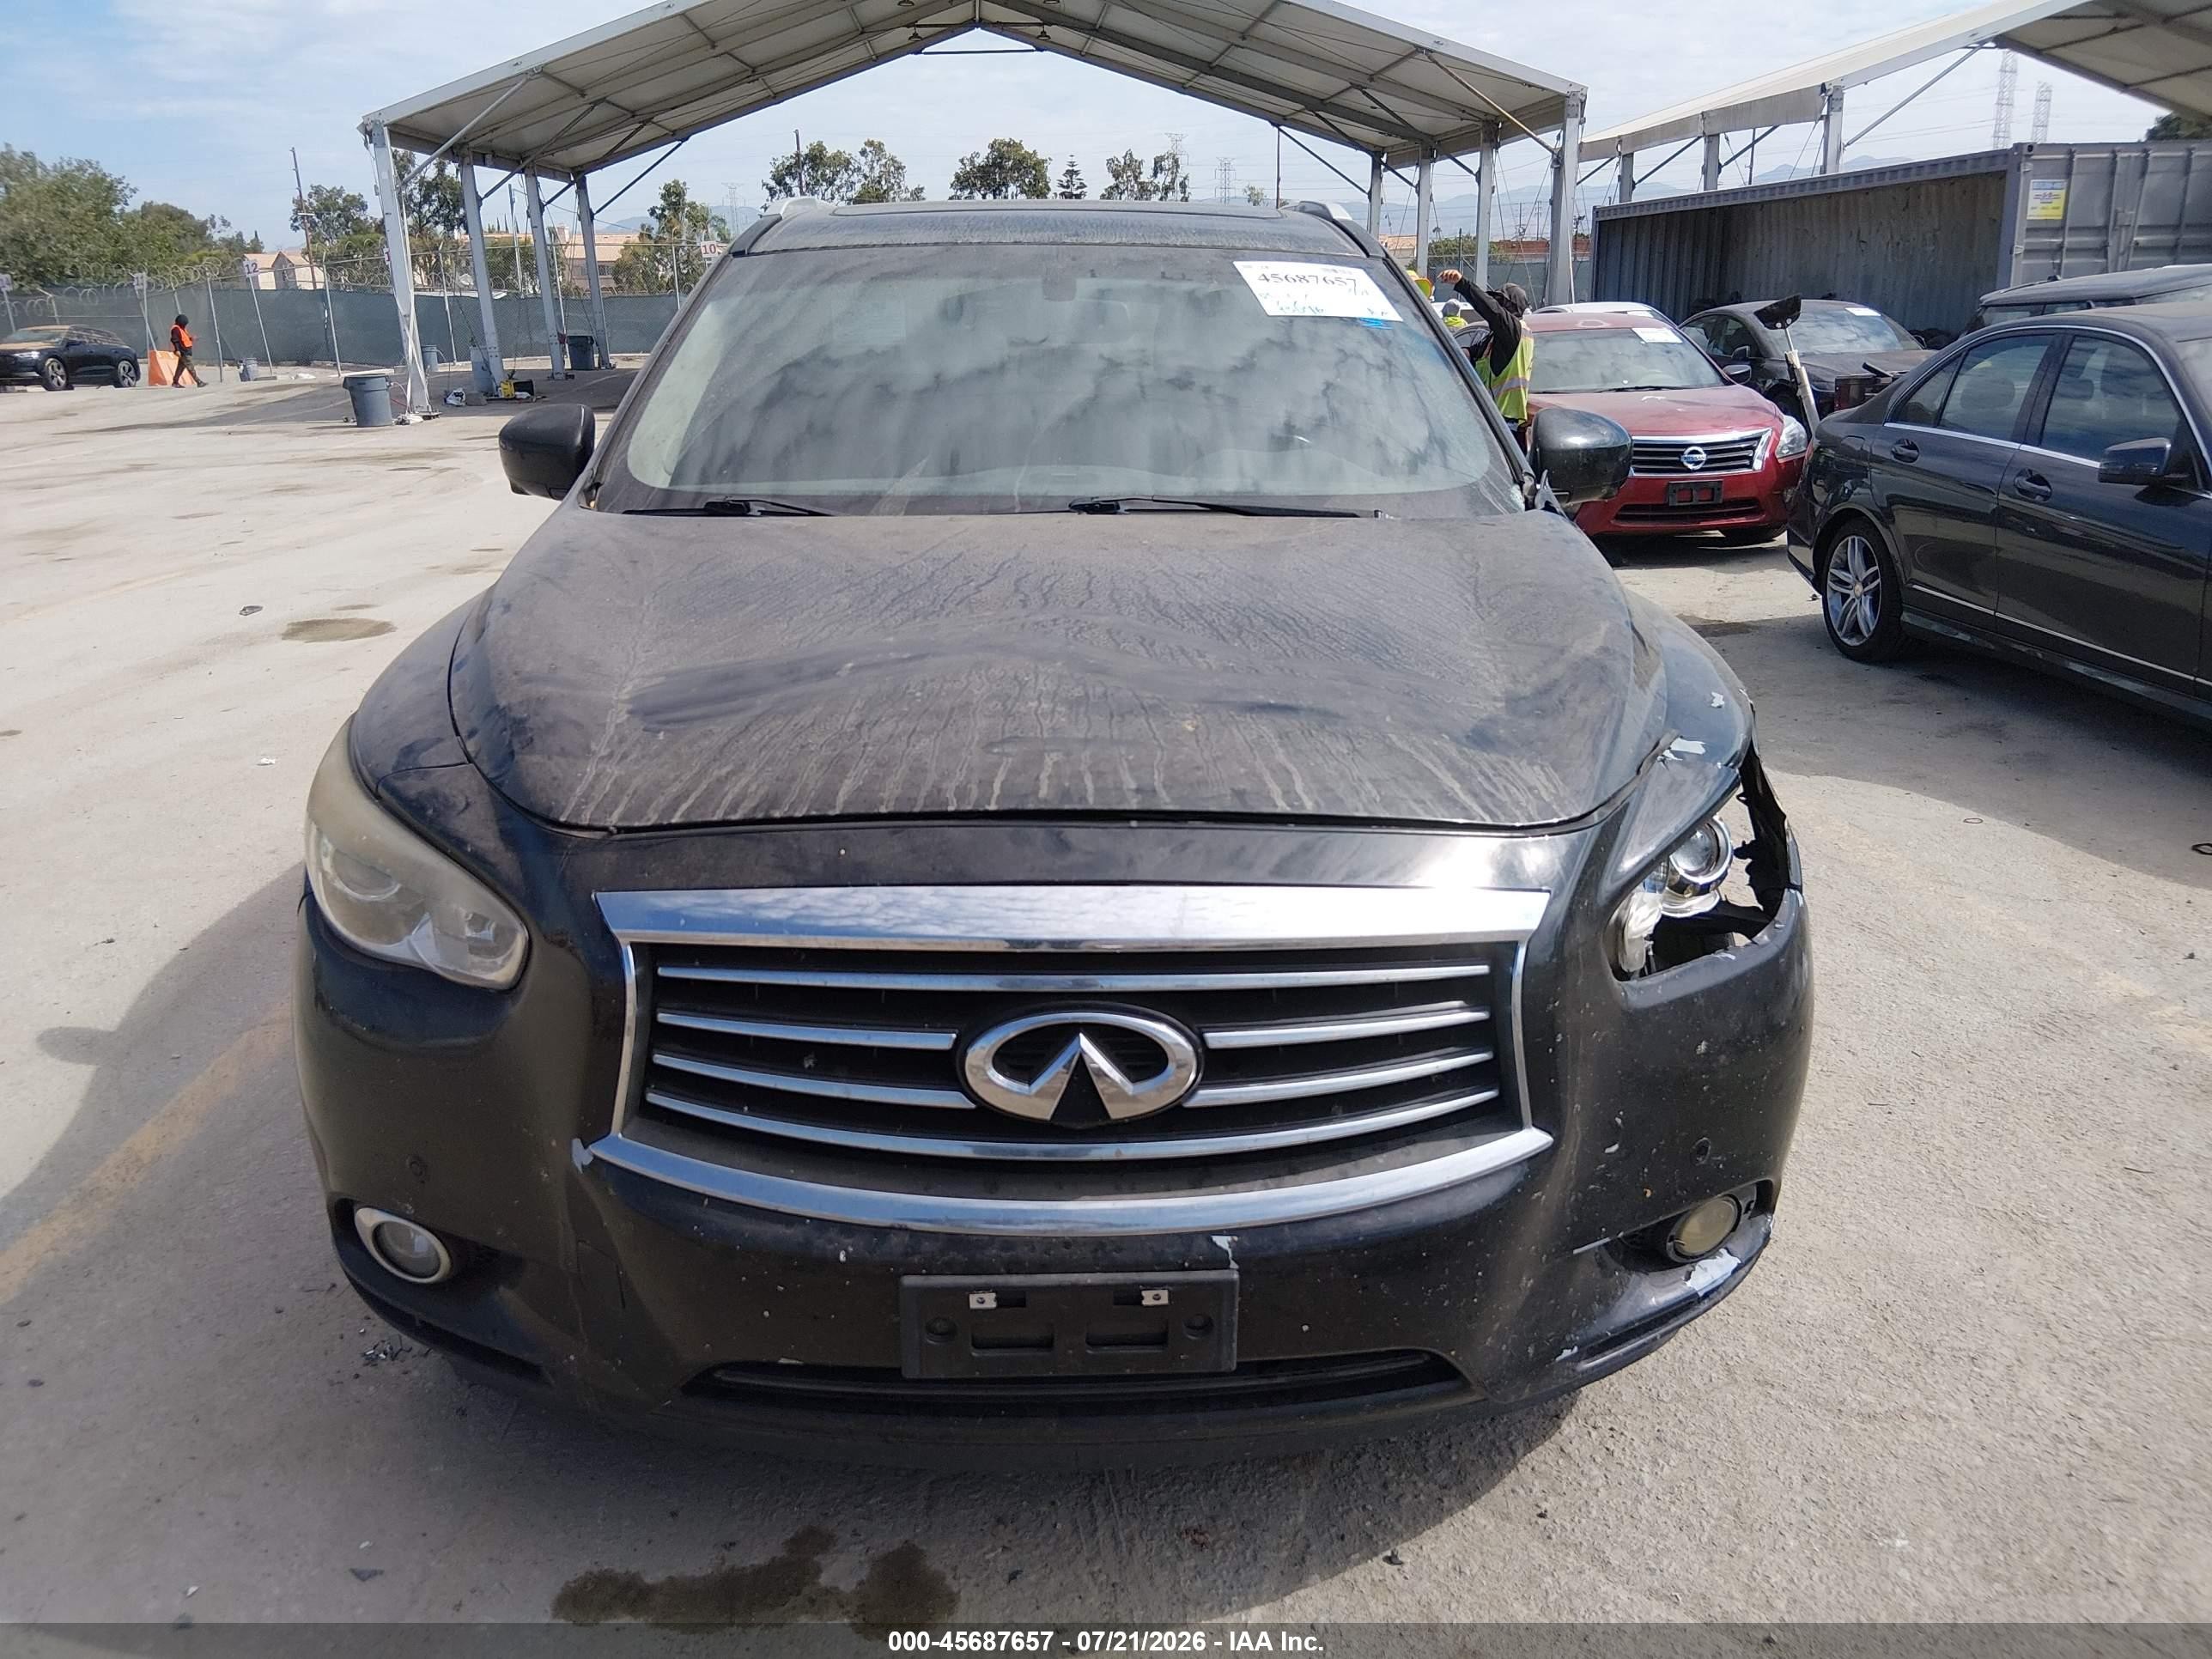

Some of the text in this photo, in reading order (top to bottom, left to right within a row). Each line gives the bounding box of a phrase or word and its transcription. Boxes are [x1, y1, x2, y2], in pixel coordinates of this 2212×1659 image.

[702, 243, 716, 255] 10
[245, 262, 259, 275] 12
[1257, 273, 1357, 296] 45687657
